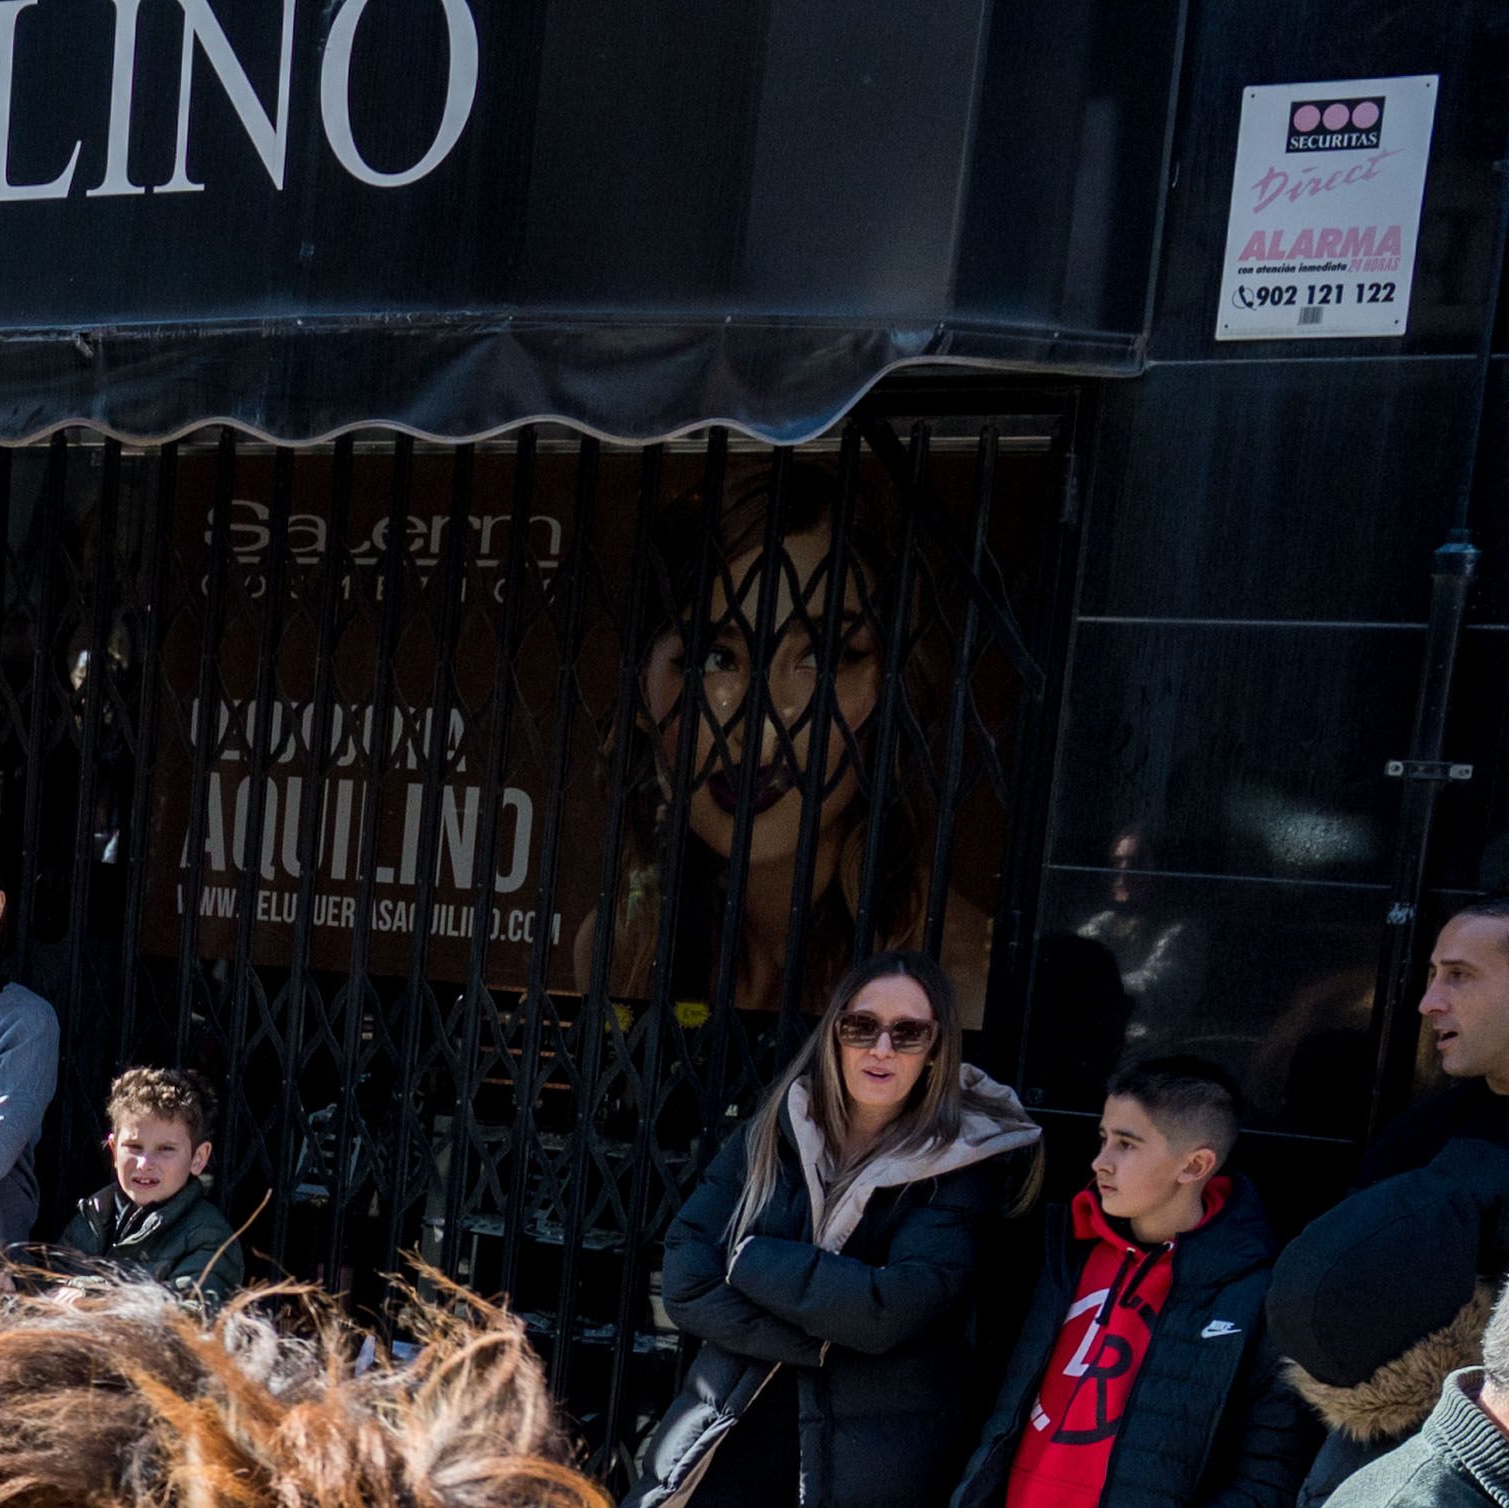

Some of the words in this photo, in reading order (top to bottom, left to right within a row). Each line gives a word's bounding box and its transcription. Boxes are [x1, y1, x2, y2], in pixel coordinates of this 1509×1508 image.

[1289, 131, 1378, 150] SECURITAS
[1251, 149, 1403, 214] Direct
[1237, 225, 1402, 262] ALARMA
[1237, 266, 1255, 275] con
[1256, 262, 1296, 274] atención
[1298, 261, 1348, 273] inmediata
[1256, 285, 1298, 306] 902
[1307, 283, 1344, 305] 121
[1356, 282, 1396, 304] 122
